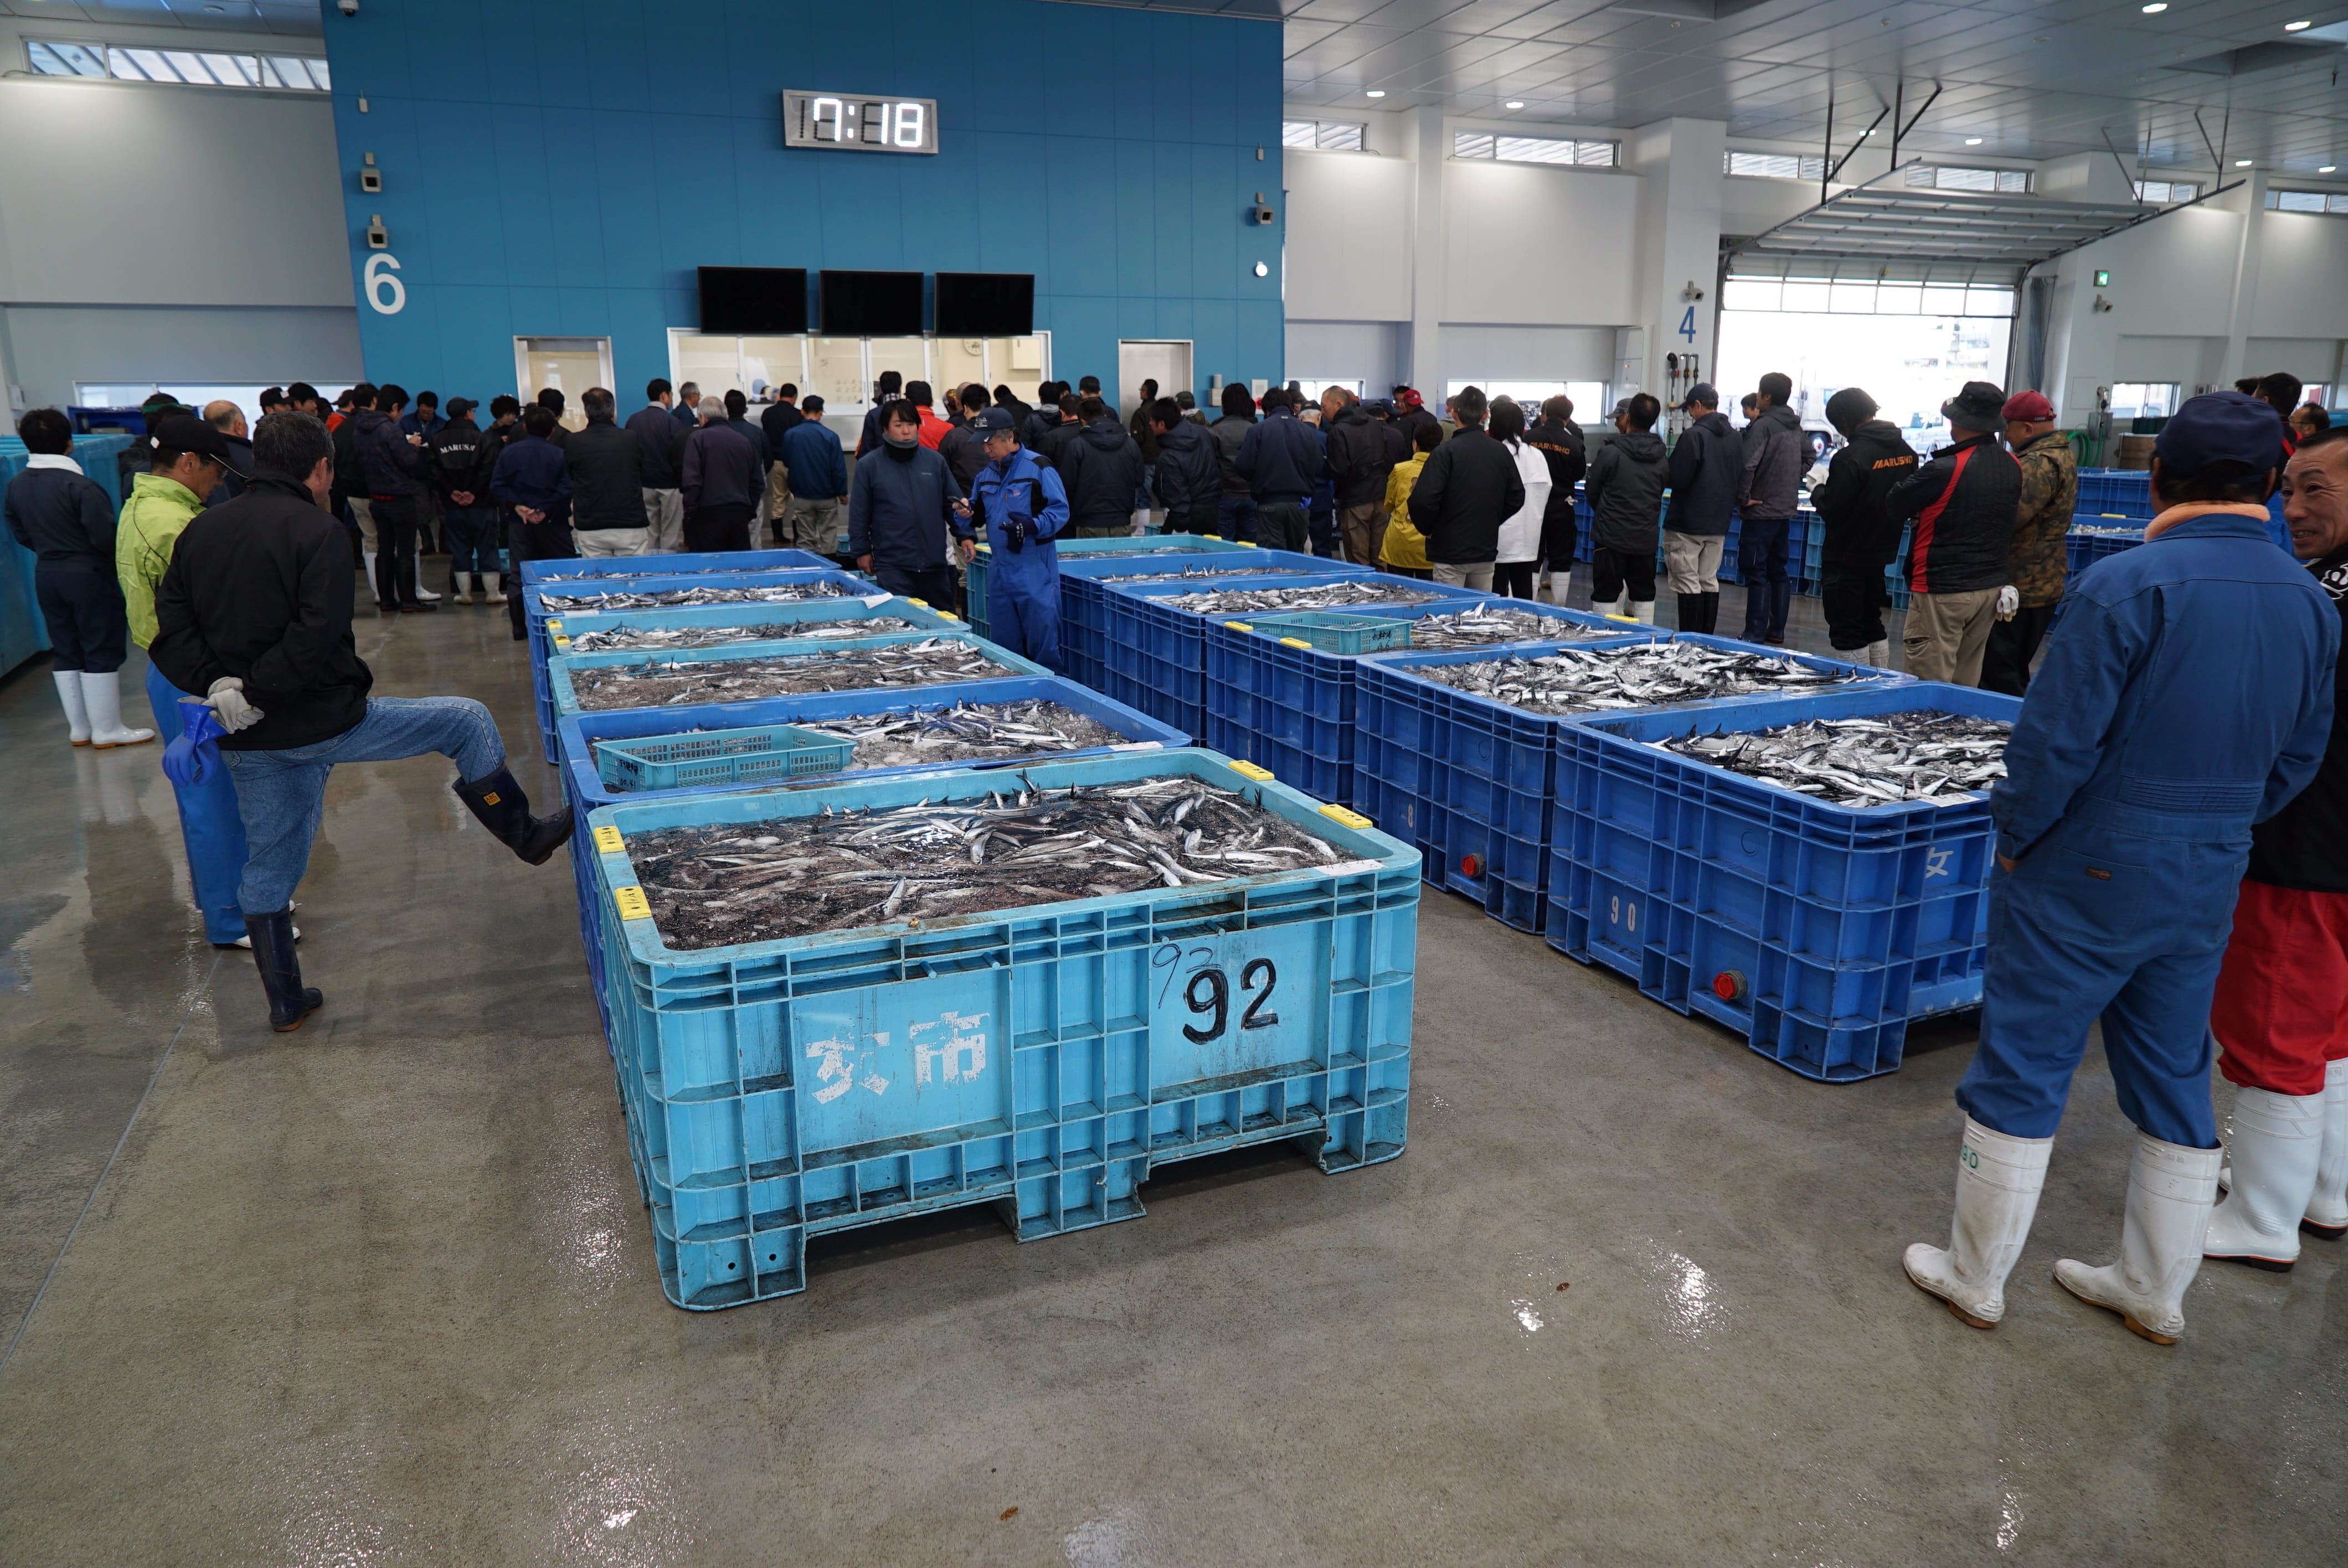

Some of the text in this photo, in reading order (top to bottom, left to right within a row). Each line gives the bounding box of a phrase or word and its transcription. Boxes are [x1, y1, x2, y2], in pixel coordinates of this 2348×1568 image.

[813, 98, 924, 147] 7:18
[364, 252, 406, 314] 6
[1678, 306, 1696, 343] 4
[1872, 455, 1913, 470] MARUSHO
[485, 793, 497, 802] ABC
[1610, 895, 1636, 932] 90
[1152, 943, 1222, 1009] 92
[1182, 958, 1279, 1045] 92
